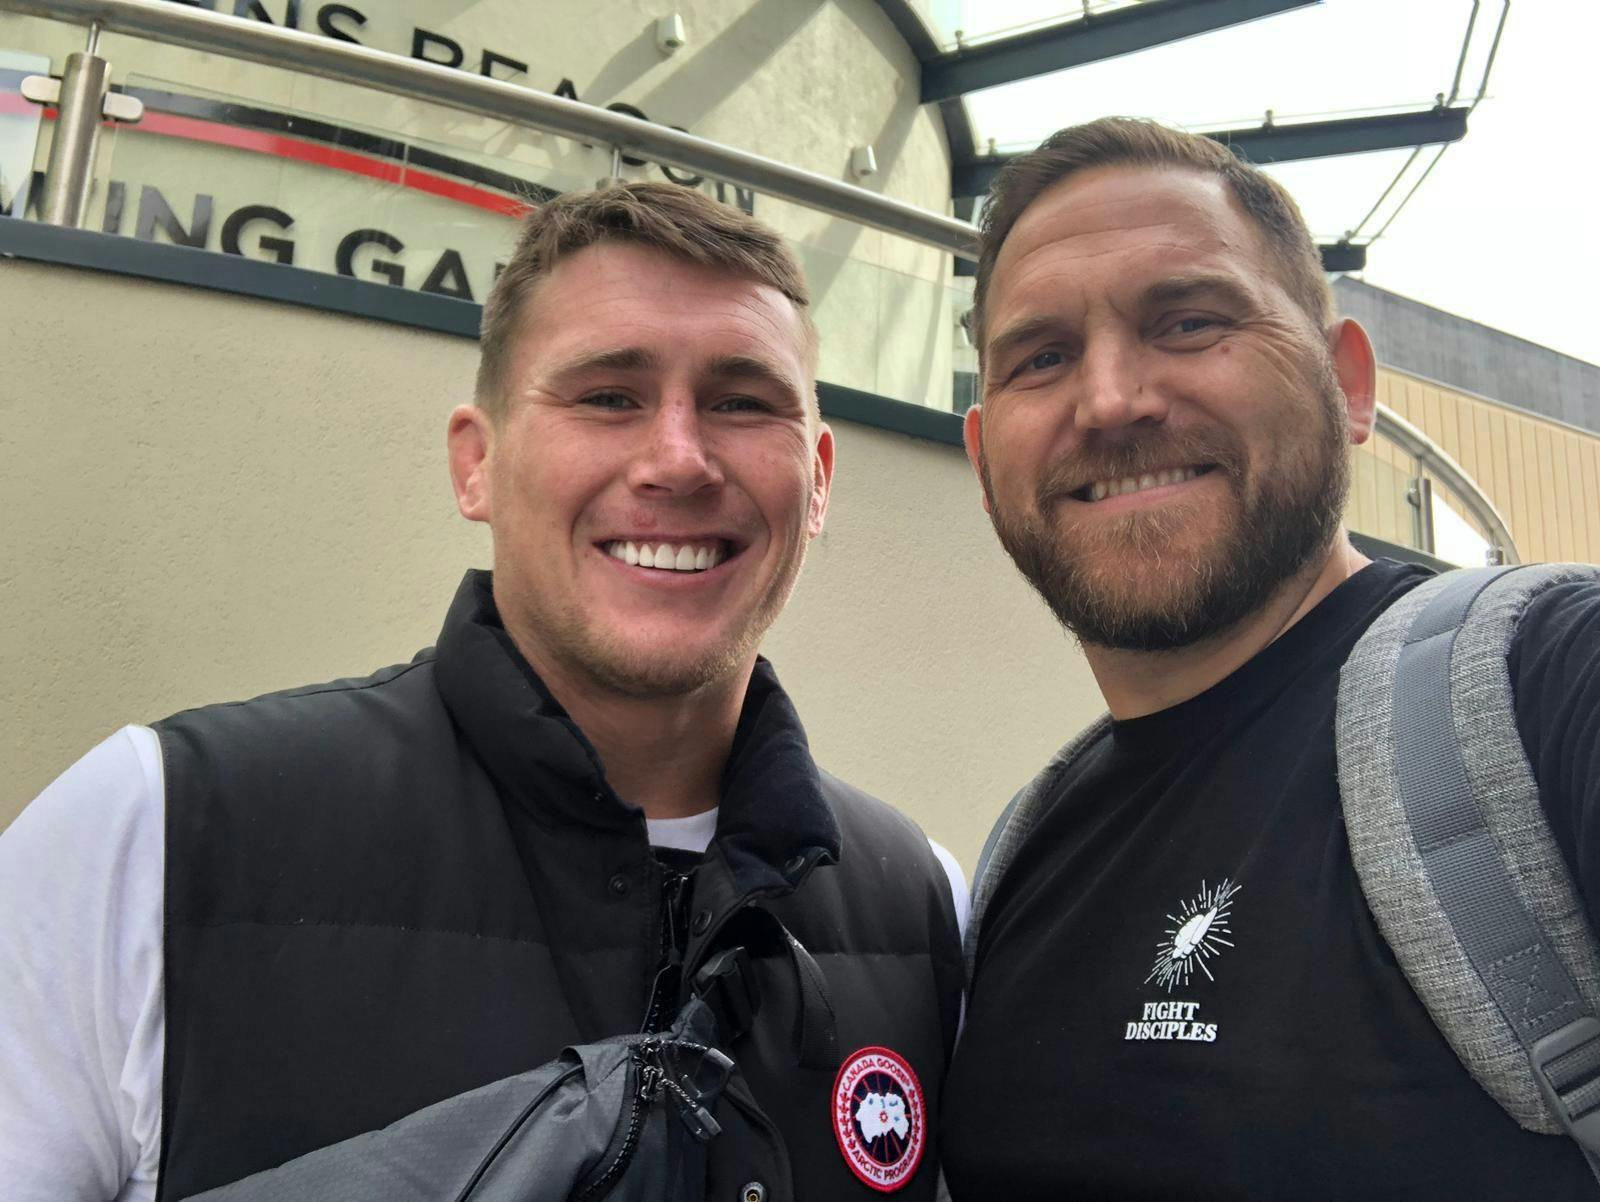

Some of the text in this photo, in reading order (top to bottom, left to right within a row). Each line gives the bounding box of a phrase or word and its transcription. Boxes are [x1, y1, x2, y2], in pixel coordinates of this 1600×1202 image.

[335, 228, 512, 301] GA
[1142, 1001, 1199, 1021] FIGHT
[1124, 1021, 1218, 1042] DISCIPLES
[842, 1058, 910, 1091] CANADA GOOSE
[852, 1145, 916, 1181] ARCTIC PROGRAM
